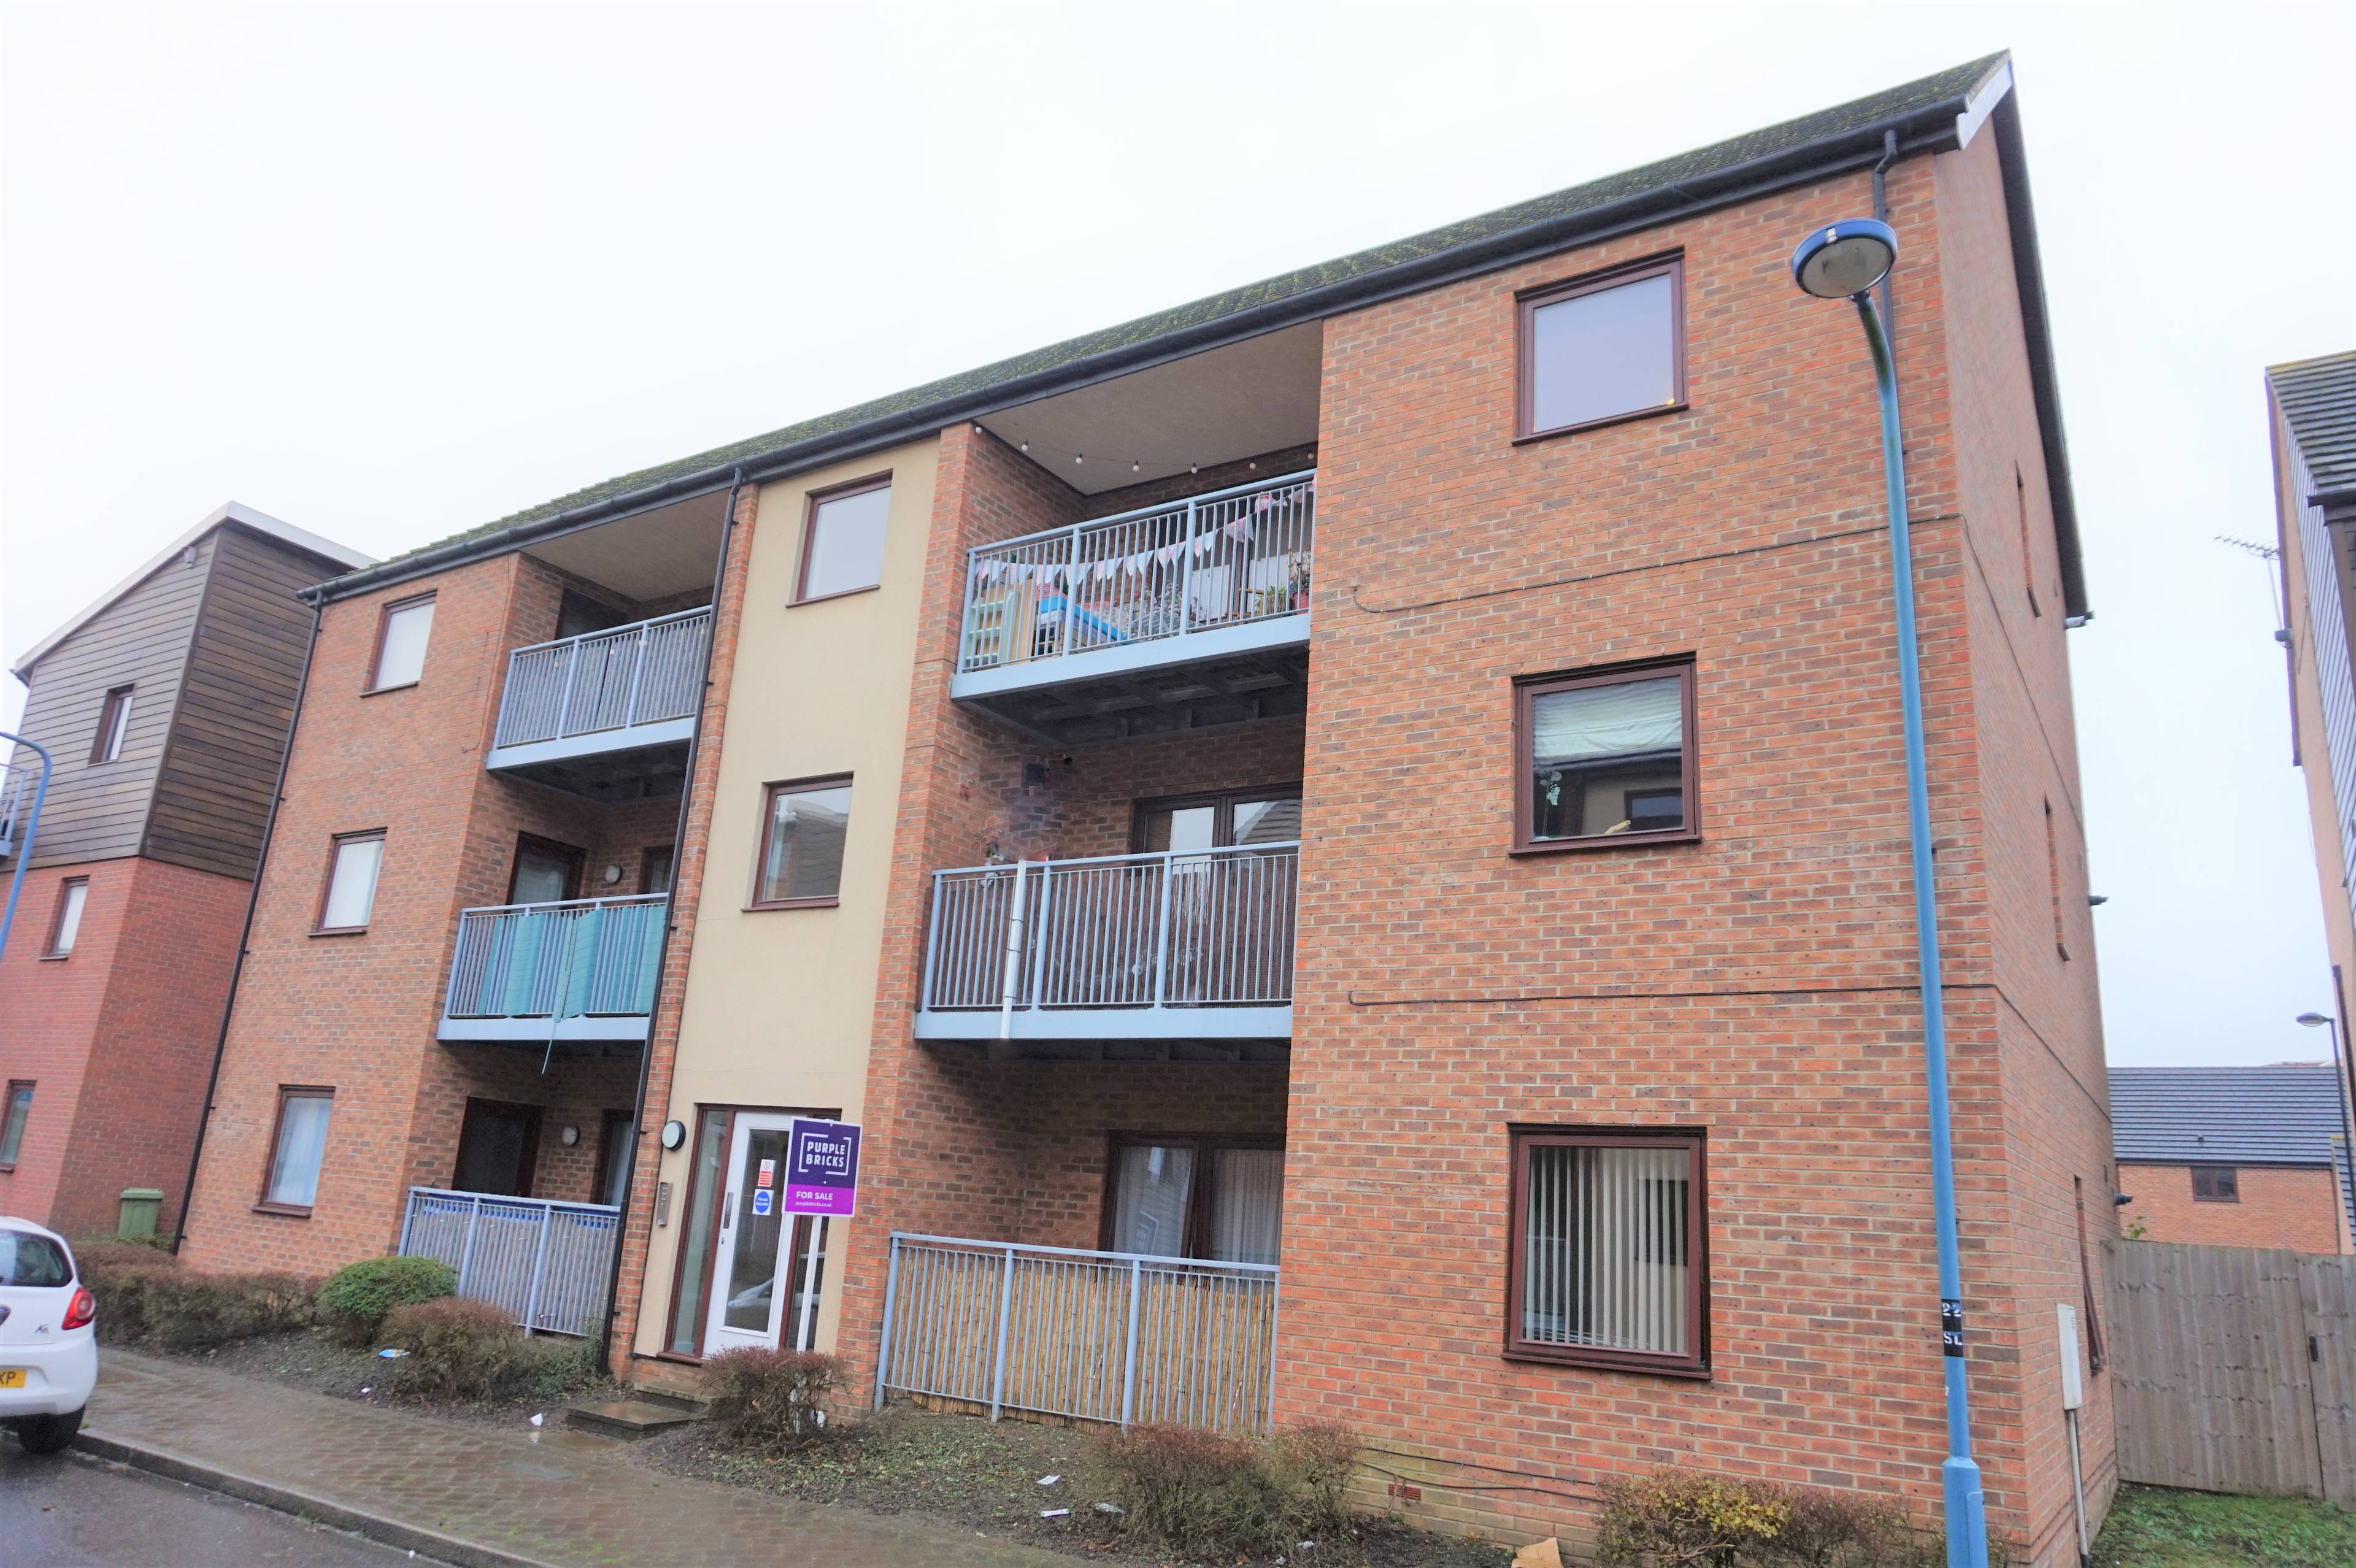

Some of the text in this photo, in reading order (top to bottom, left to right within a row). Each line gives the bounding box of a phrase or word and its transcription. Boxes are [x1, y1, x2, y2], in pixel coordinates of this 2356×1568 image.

[807, 1142, 845, 1155] PURPLE
[806, 1154, 844, 1167] BRICKS
[815, 1192, 833, 1201] SALE
